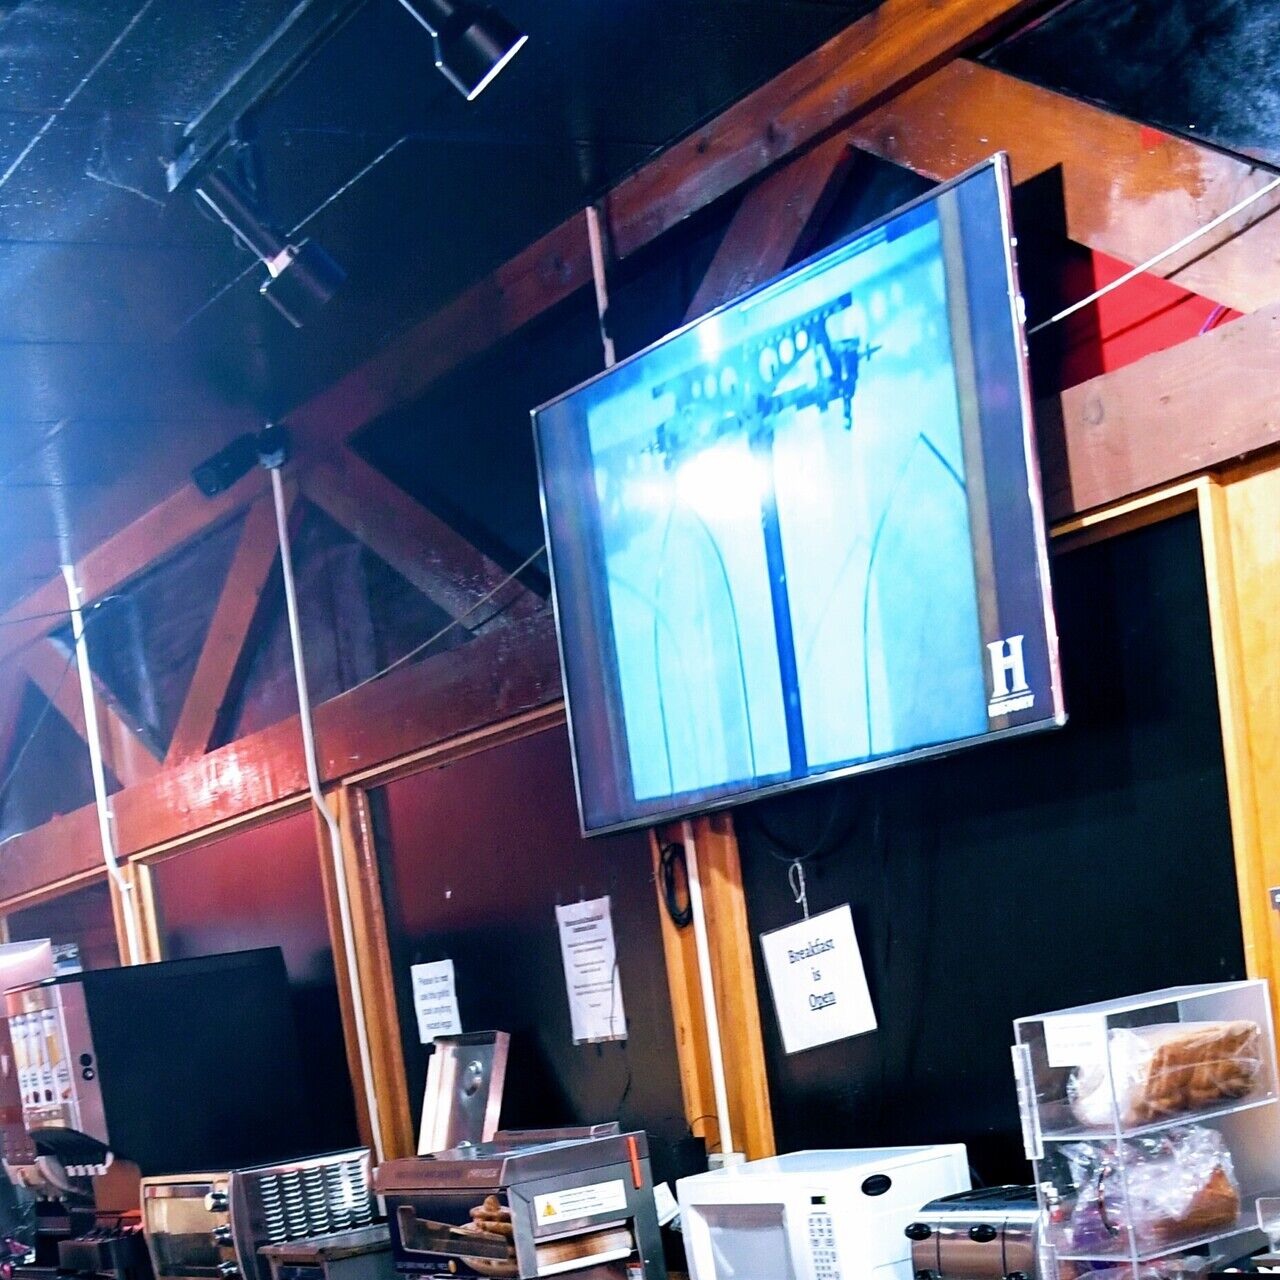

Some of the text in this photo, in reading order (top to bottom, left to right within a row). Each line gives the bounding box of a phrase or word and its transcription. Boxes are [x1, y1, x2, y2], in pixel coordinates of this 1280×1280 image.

[986, 634, 1030, 699] H
[787, 938, 835, 964] Breakfast
[811, 966, 822, 982] is
[808, 991, 837, 1011] Open
